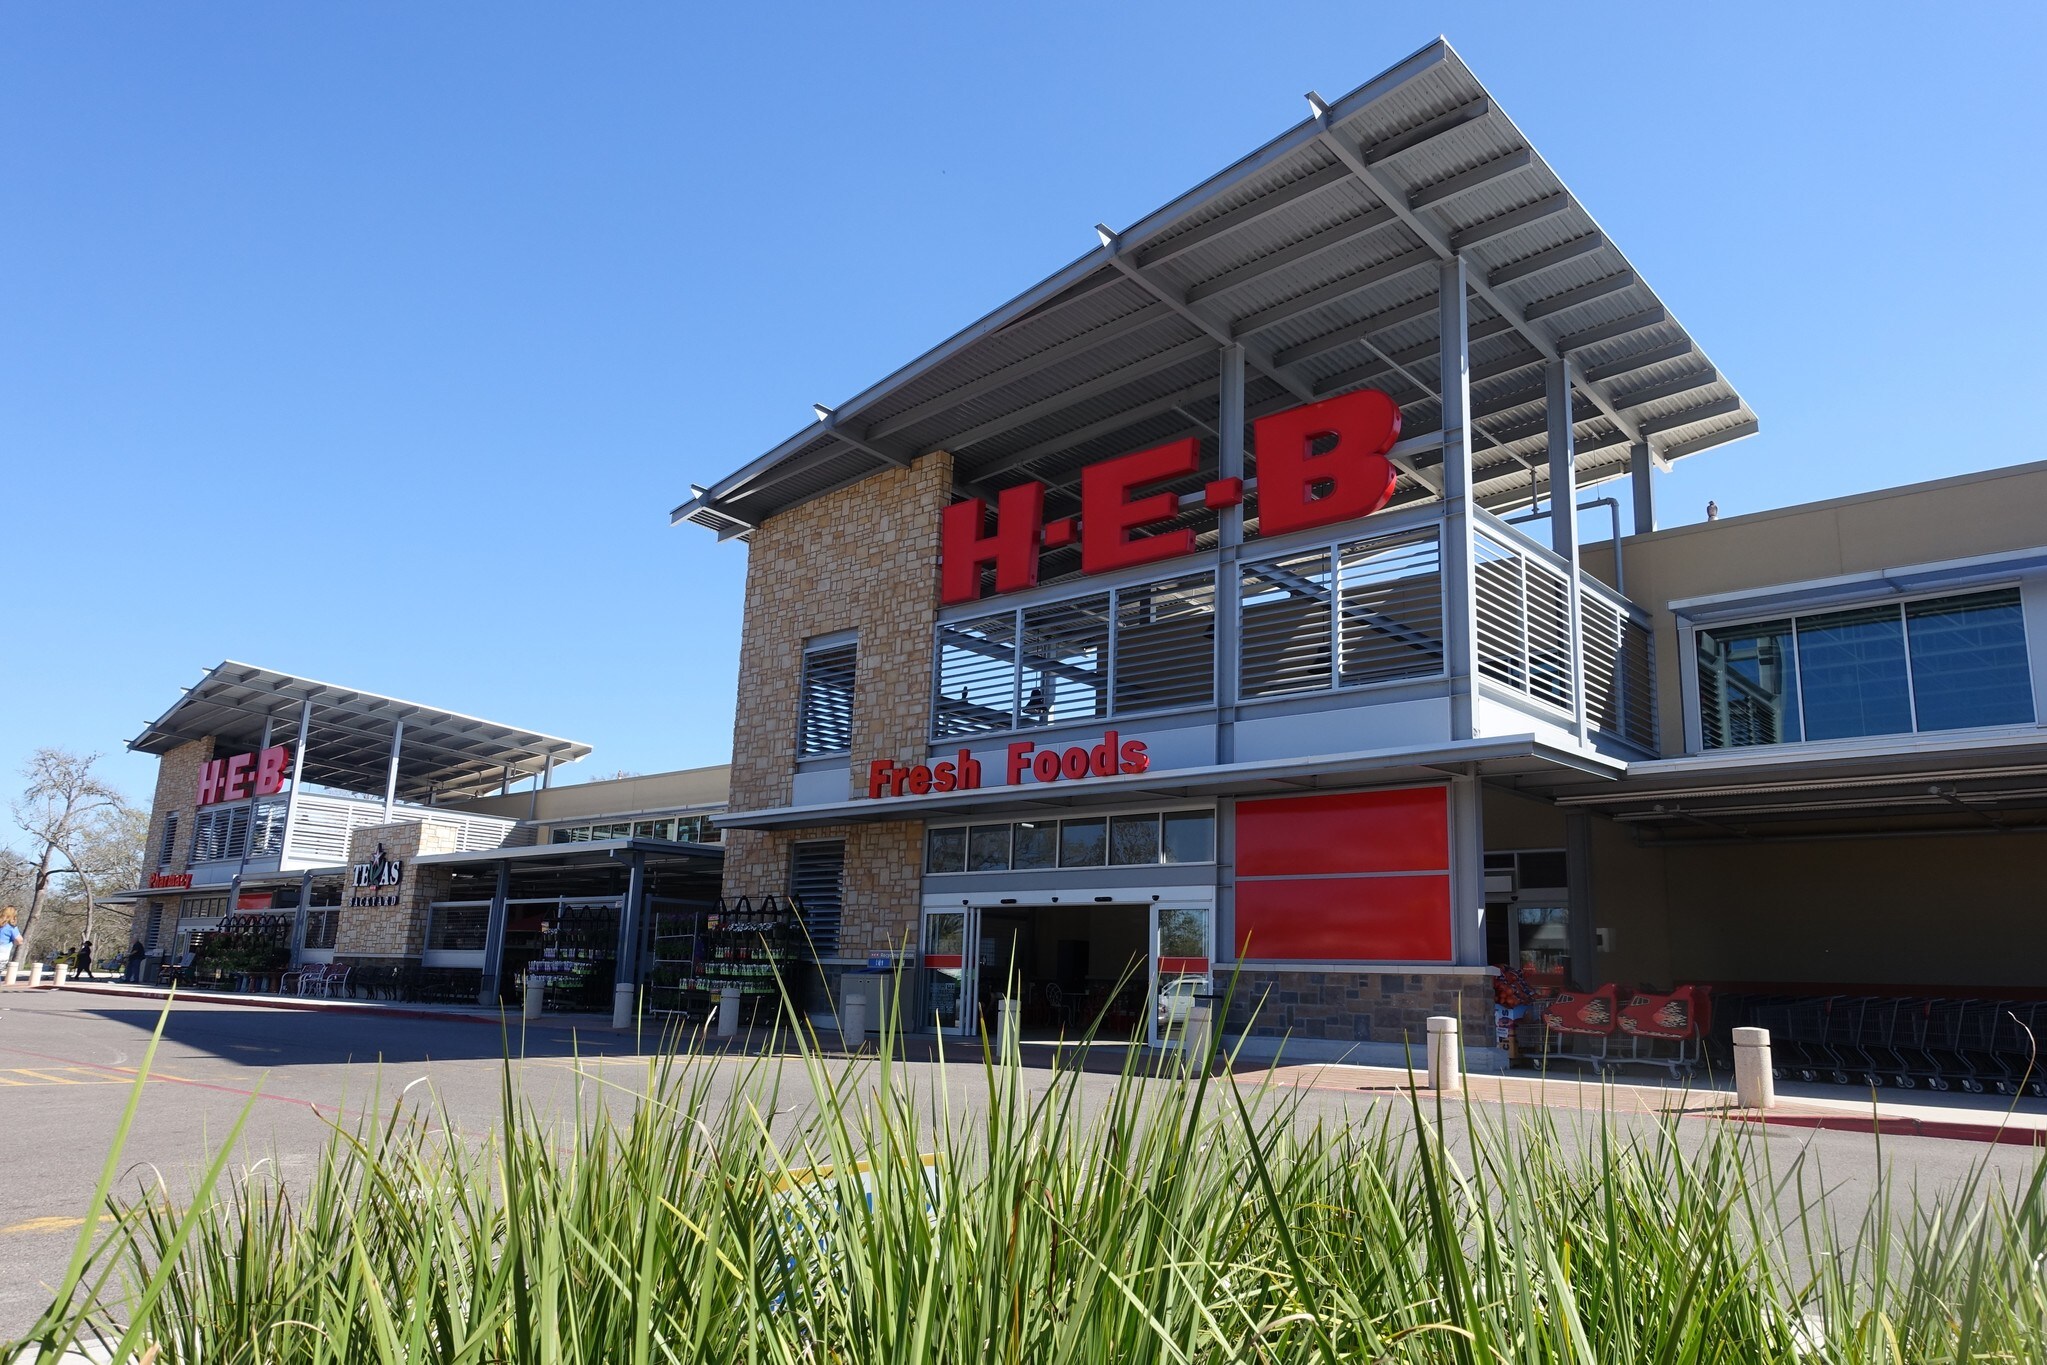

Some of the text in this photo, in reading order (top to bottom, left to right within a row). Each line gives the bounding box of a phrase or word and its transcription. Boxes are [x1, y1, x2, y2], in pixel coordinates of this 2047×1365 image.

[868, 730, 1150, 799] Fresh Foods
[147, 871, 193, 890] Pharmacy
[880, 952, 900, 960] Recycing
